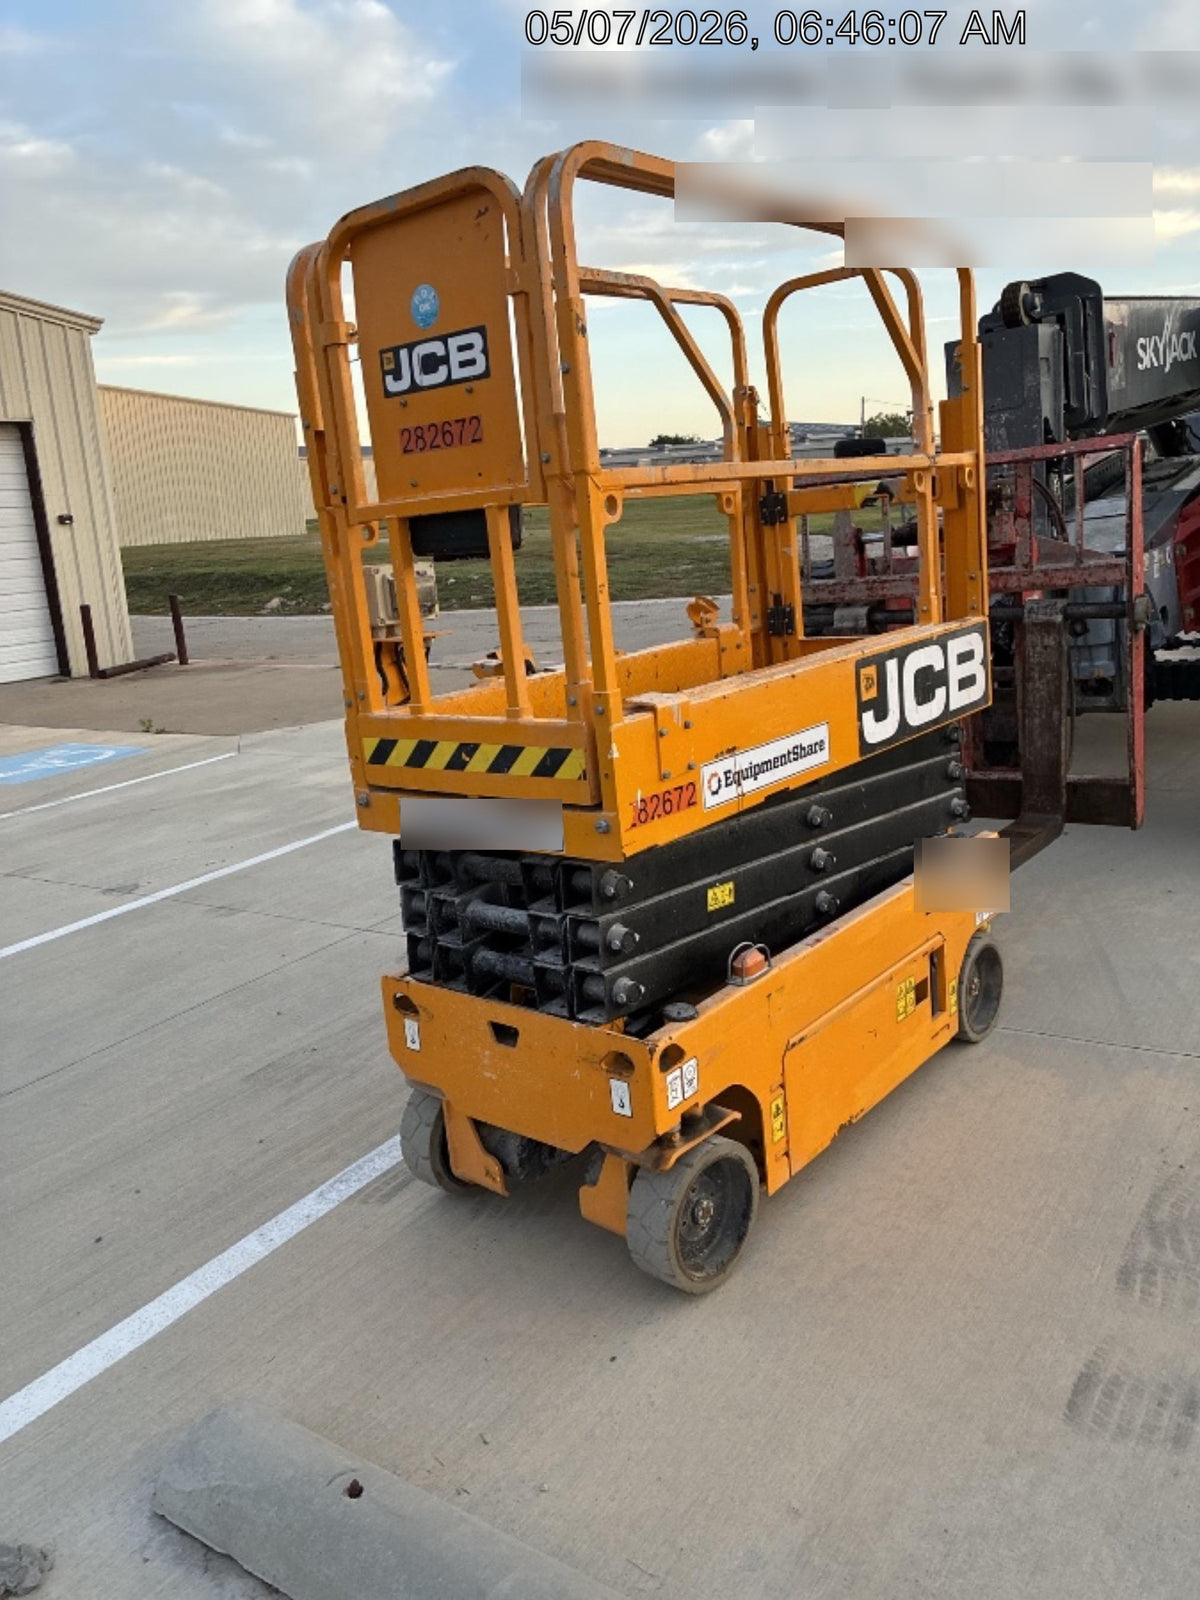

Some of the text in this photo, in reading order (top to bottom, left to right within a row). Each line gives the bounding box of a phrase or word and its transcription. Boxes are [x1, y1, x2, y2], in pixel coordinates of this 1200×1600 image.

[385, 331, 487, 393] JCB
[1136, 316, 1197, 373] SKYJACK
[401, 415, 483, 453] 282672
[861, 632, 986, 744] JCB
[723, 739, 826, 787] EquipmentShare
[629, 781, 697, 827] 82672
